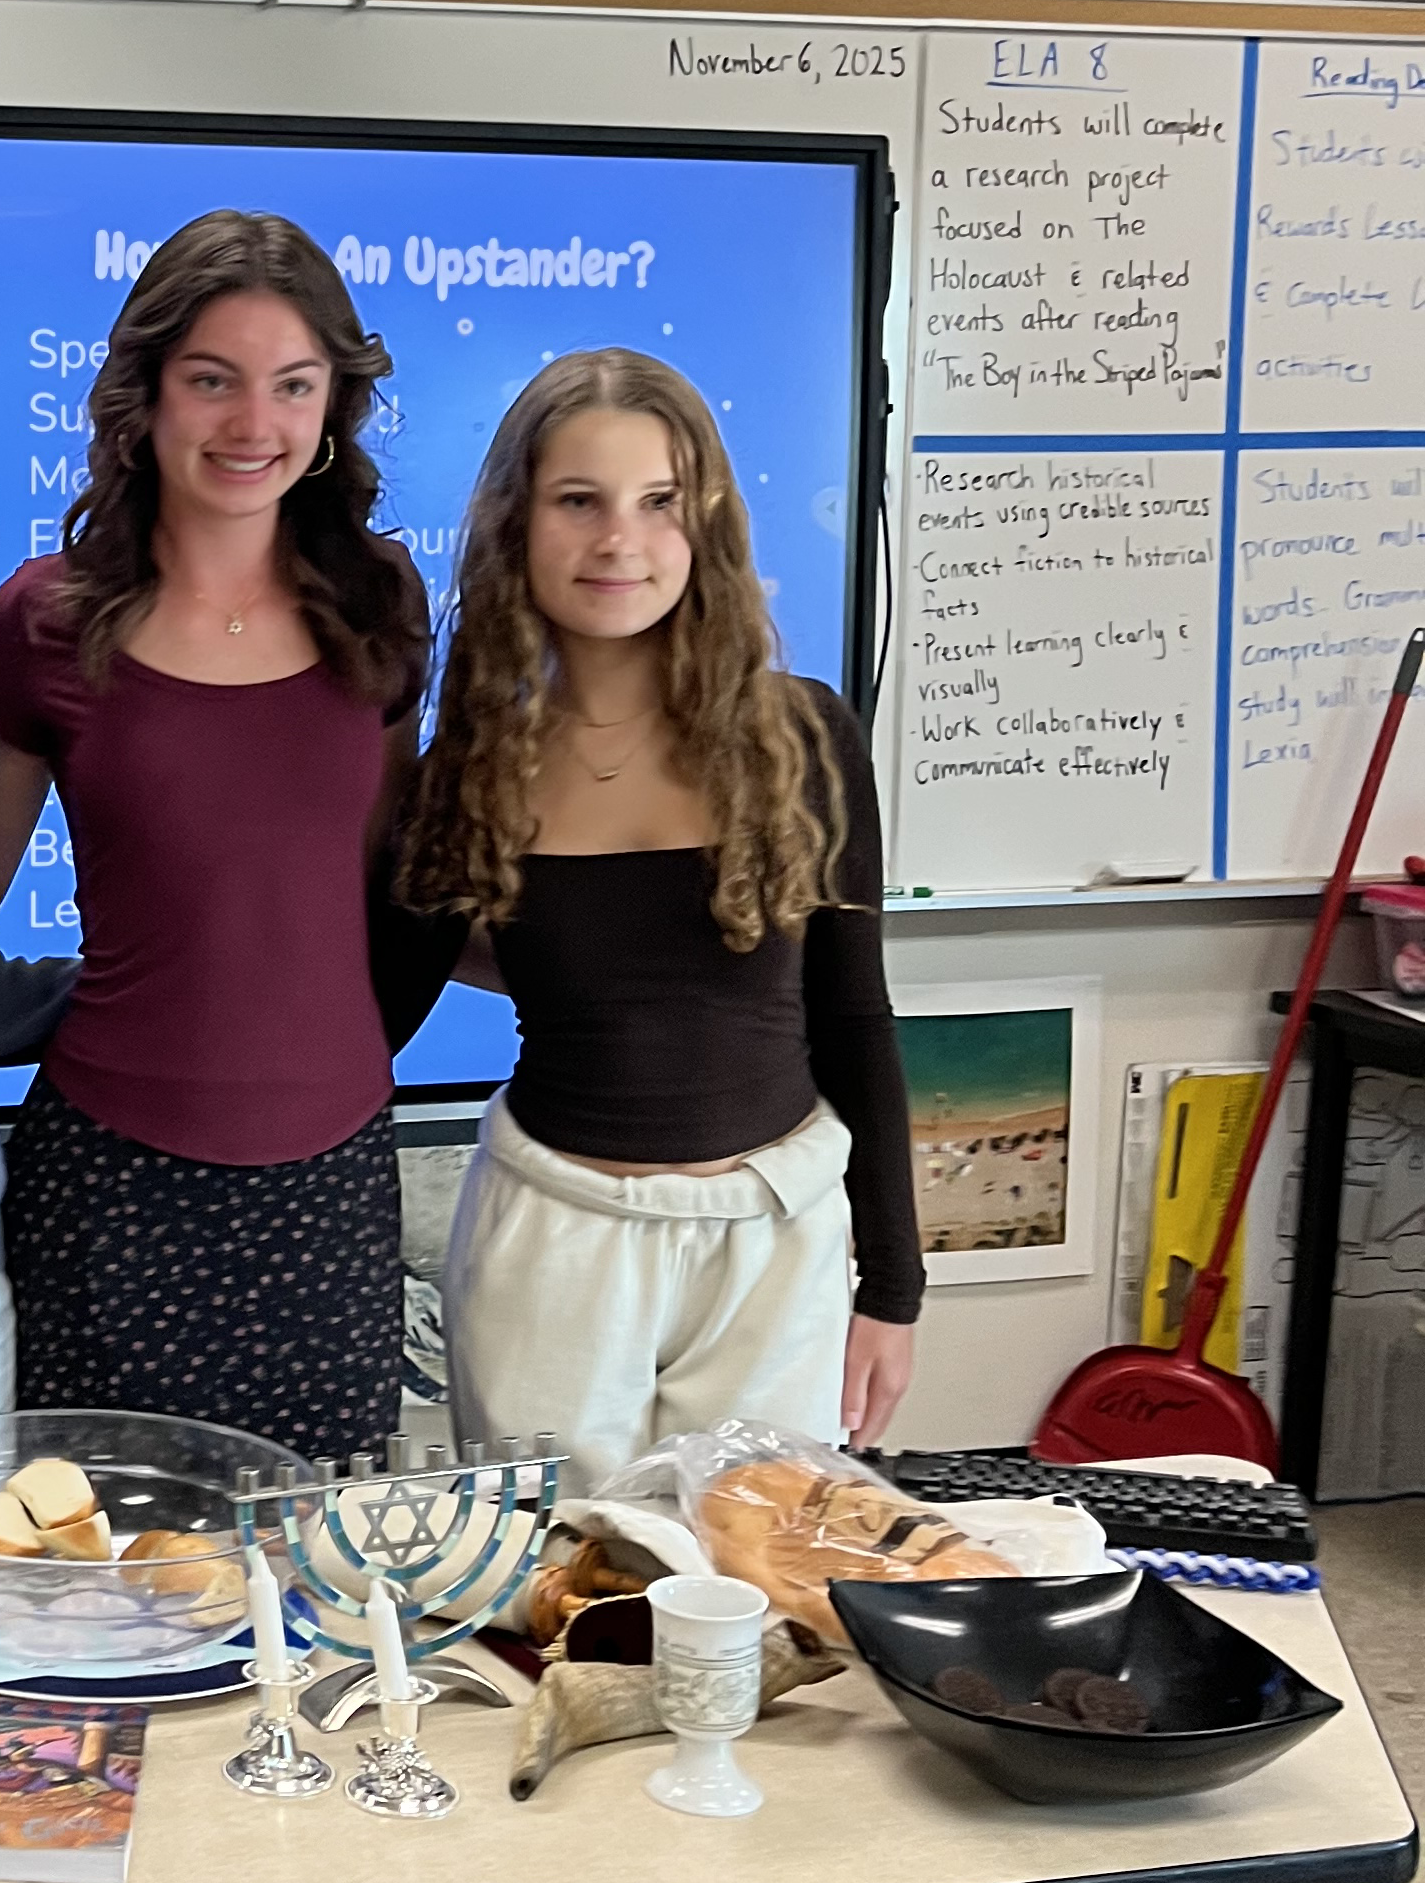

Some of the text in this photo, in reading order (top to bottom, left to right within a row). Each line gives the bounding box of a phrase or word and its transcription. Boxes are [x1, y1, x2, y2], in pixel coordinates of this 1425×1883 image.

[669, 36, 907, 85] November 6, 2025
[992, 39, 1109, 80] ELA 8
[938, 98, 1227, 146] Students will complete
[931, 158, 1172, 206] a research project
[931, 205, 1146, 241] focused on The
[95, 228, 162, 281] Ho
[403, 236, 656, 302] Upstander?
[929, 257, 1047, 291] Holocaust
[1102, 259, 1190, 291] related
[926, 297, 1179, 349] events after reading
[29, 328, 111, 378] Spe
[982, 351, 1022, 398] Boy
[1028, 360, 1048, 385] in
[1050, 357, 1086, 387] the
[1092, 348, 1157, 397] Striped
[1046, 457, 1155, 493] historical
[1252, 467, 1372, 504] Students
[917, 492, 1211, 539] events using credible sources
[1013, 543, 1084, 572] fiction
[1092, 548, 1115, 567] to
[1124, 535, 1216, 567] historical
[920, 588, 980, 622] facts
[1006, 628, 1084, 668] learning
[1094, 617, 1167, 661] clearly
[918, 667, 1001, 705] visually
[996, 708, 1163, 742] collaboratively
[1058, 745, 1172, 792] effectively
[1242, 738, 1313, 770] Lexia
[30, 890, 79, 928] Le
